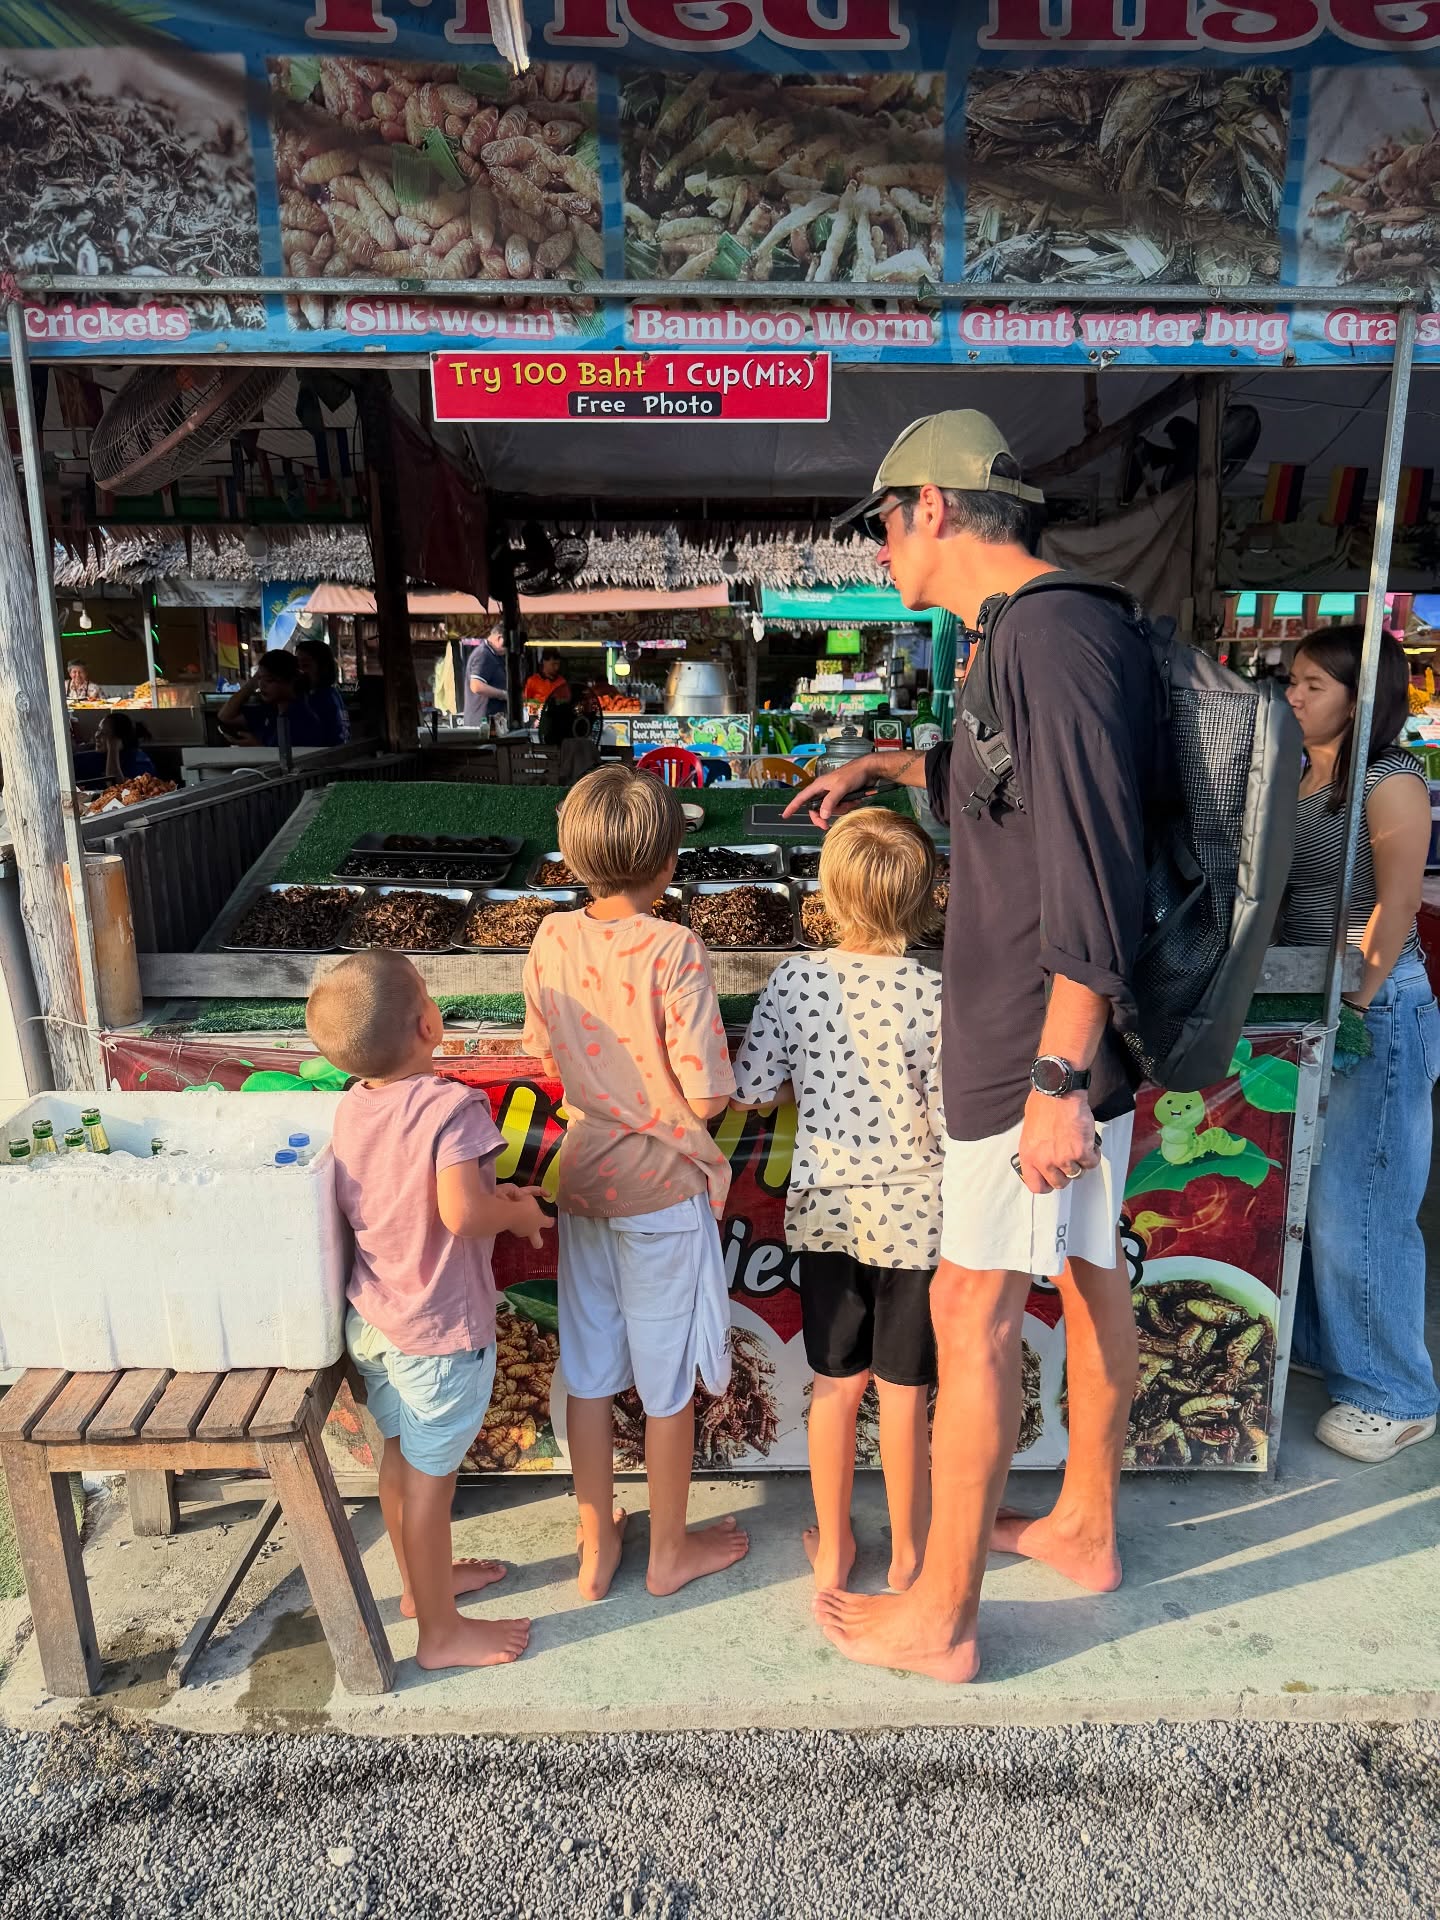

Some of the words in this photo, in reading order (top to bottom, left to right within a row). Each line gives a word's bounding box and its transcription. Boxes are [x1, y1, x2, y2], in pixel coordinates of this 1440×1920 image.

[23, 305, 186, 338] Crickets
[637, 309, 801, 342] Bamboo
[815, 311, 930, 343] Worm
[963, 311, 1070, 342] Giant
[1084, 312, 1197, 343] water
[1209, 311, 1286, 349] bug
[1328, 311, 1440, 342] Gras
[449, 362, 501, 393] Try
[512, 361, 567, 385] 100
[578, 358, 646, 387] Baht
[664, 362, 675, 386] 1
[686, 358, 815, 394] Cup(Mix)
[577, 396, 626, 414] Free
[642, 395, 714, 415] Photo
[633, 720, 662, 729] Crocodile
[663, 720, 679, 729] Meat
